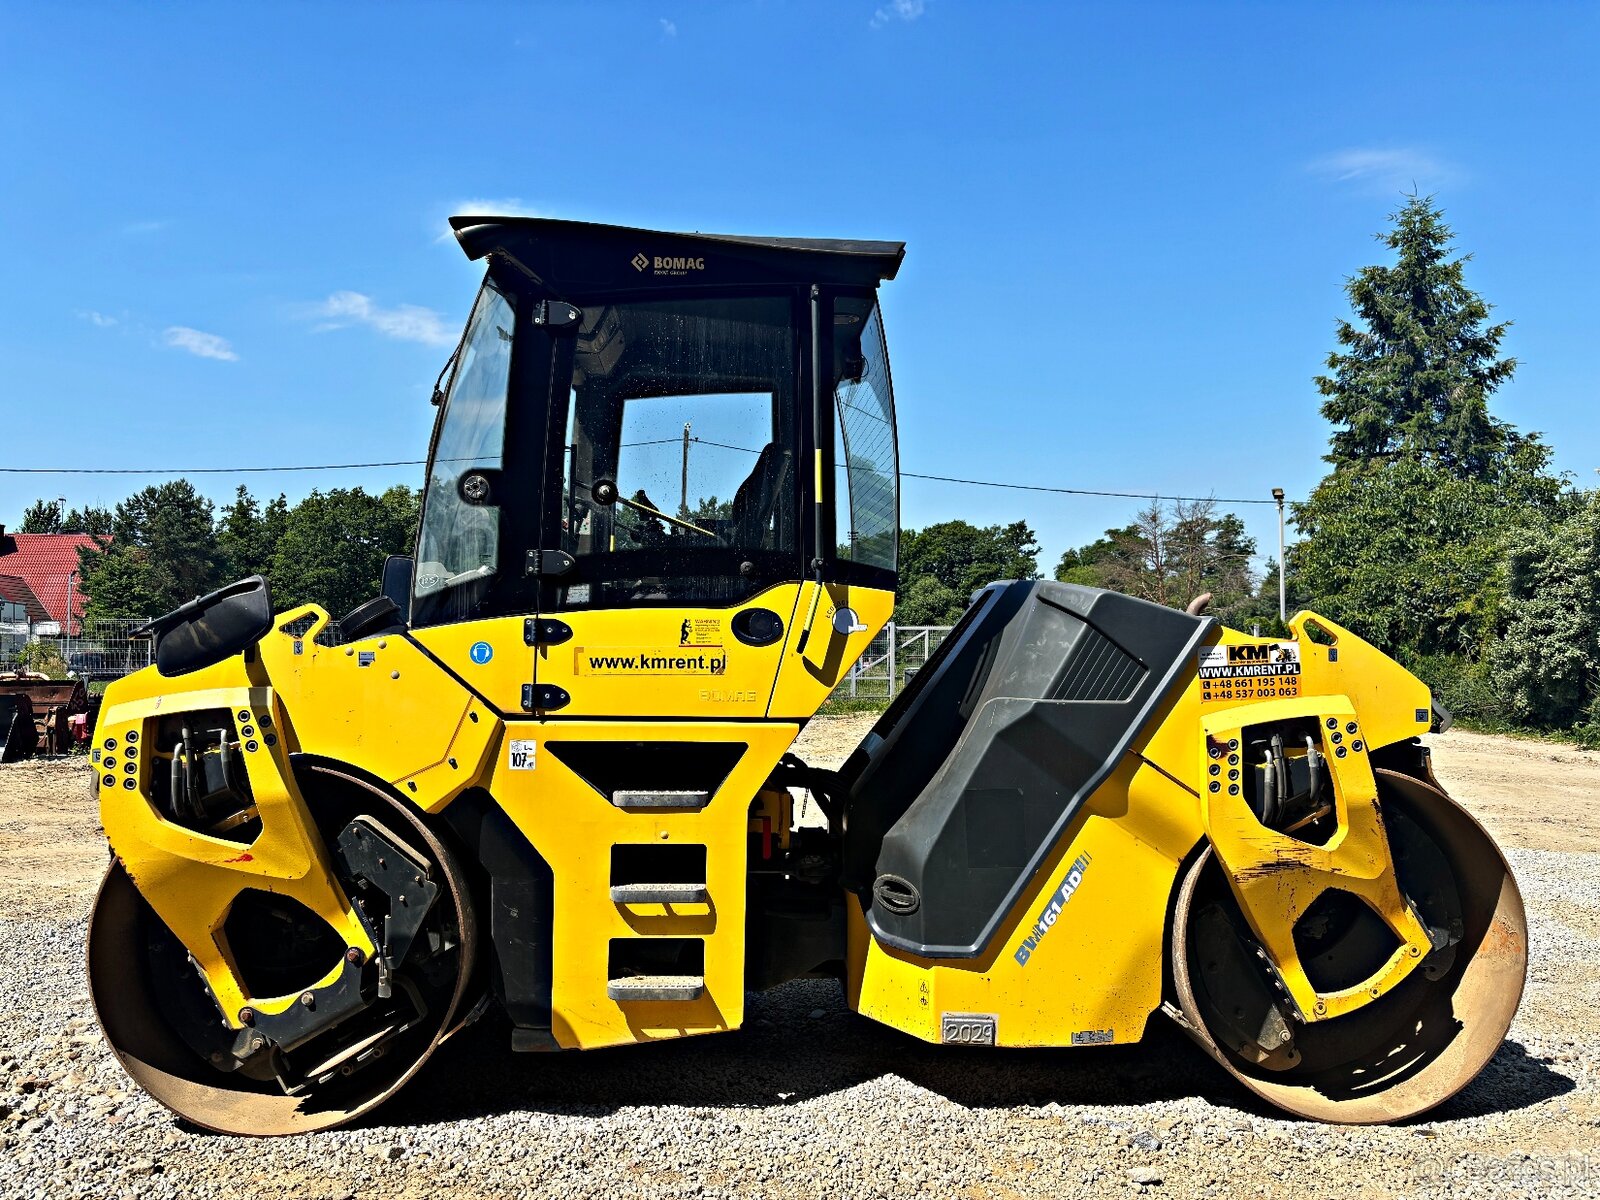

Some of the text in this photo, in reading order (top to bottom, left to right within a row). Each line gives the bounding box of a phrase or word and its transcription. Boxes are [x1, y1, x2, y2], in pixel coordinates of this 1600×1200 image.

[653, 256, 705, 270] BOMAG
[1229, 645, 1268, 661] KM
[589, 654, 726, 674] www.kmrent.pl
[1199, 664, 1299, 678] WWW.KMRENT.PL
[1213, 677, 1297, 689] +48 661 195 148
[699, 690, 756, 702] BOMAG
[1213, 687, 1297, 699] +48 537 003 063
[511, 752, 527, 767] 107
[1039, 901, 1062, 932] 161
[1061, 870, 1082, 902] AD
